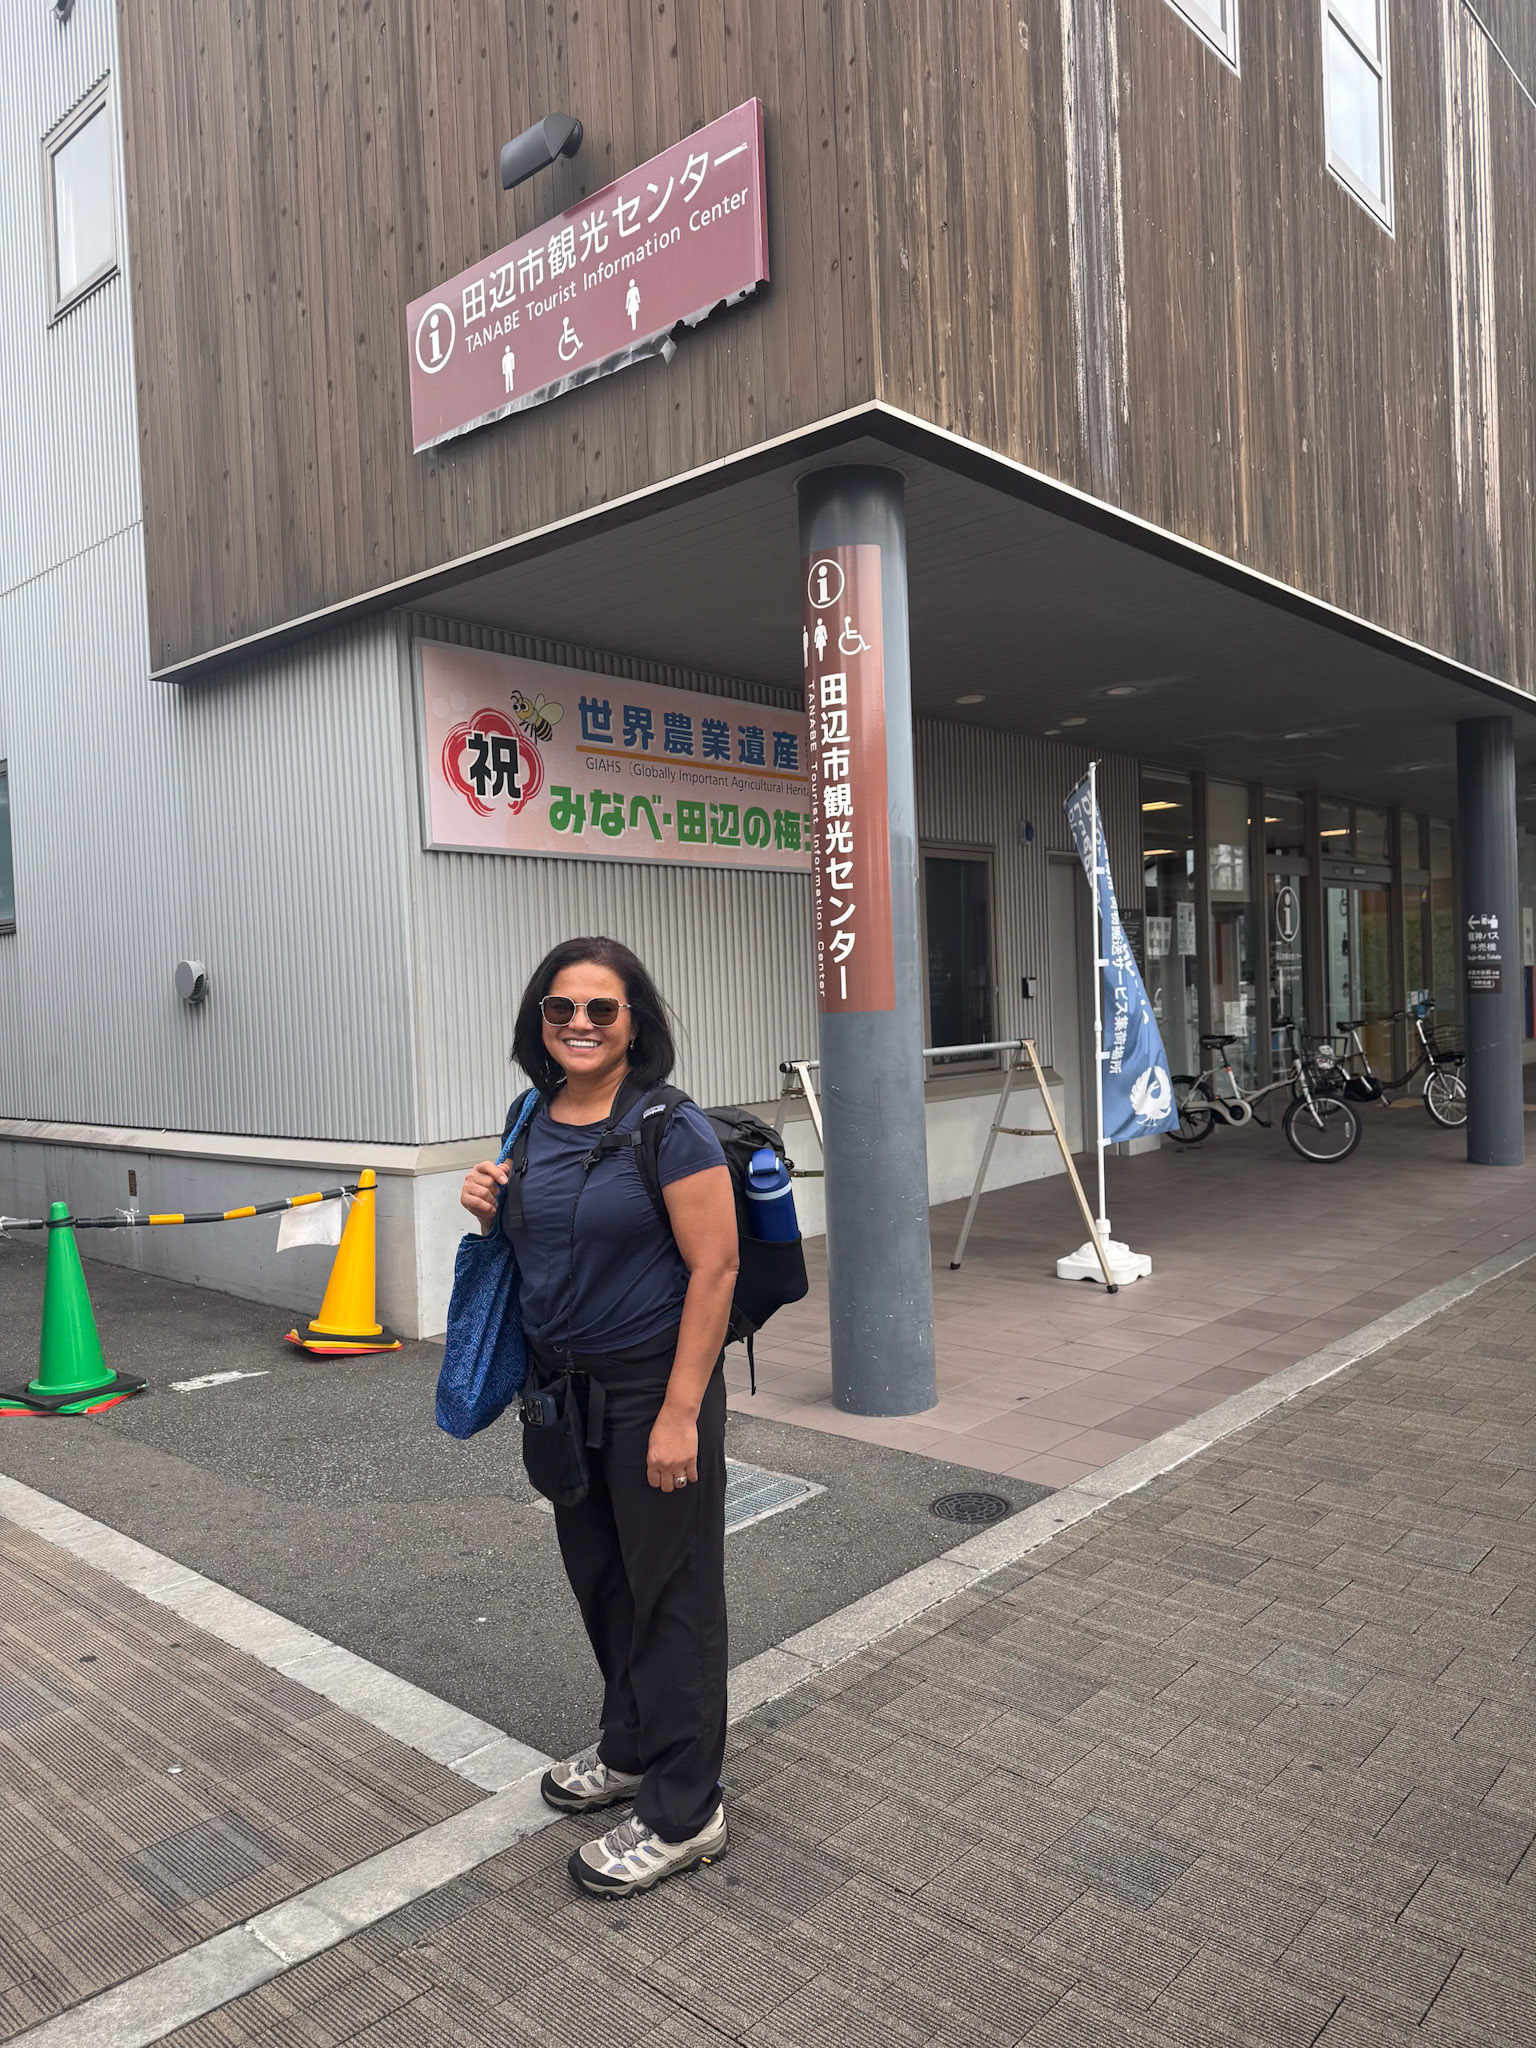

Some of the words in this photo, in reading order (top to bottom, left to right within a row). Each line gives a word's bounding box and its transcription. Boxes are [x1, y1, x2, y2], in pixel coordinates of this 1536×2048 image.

[462, 142, 748, 328] 田辺市観光センター
[465, 310, 520, 353] TANABE
[526, 281, 577, 321] Tourist
[583, 225, 681, 291] Information
[689, 188, 749, 232] Center
[578, 696, 799, 771] 世界農業遺産
[808, 680, 817, 752] TANABE
[467, 732, 522, 799] 祝
[586, 757, 622, 774] GIAHS
[679, 769, 729, 787] Important
[731, 776, 784, 794] Agricultural
[810, 761, 820, 824] Tourist
[820, 672, 856, 1000] 田辺市観光センター
[813, 833, 824, 931] Information
[817, 941, 826, 998] Center
